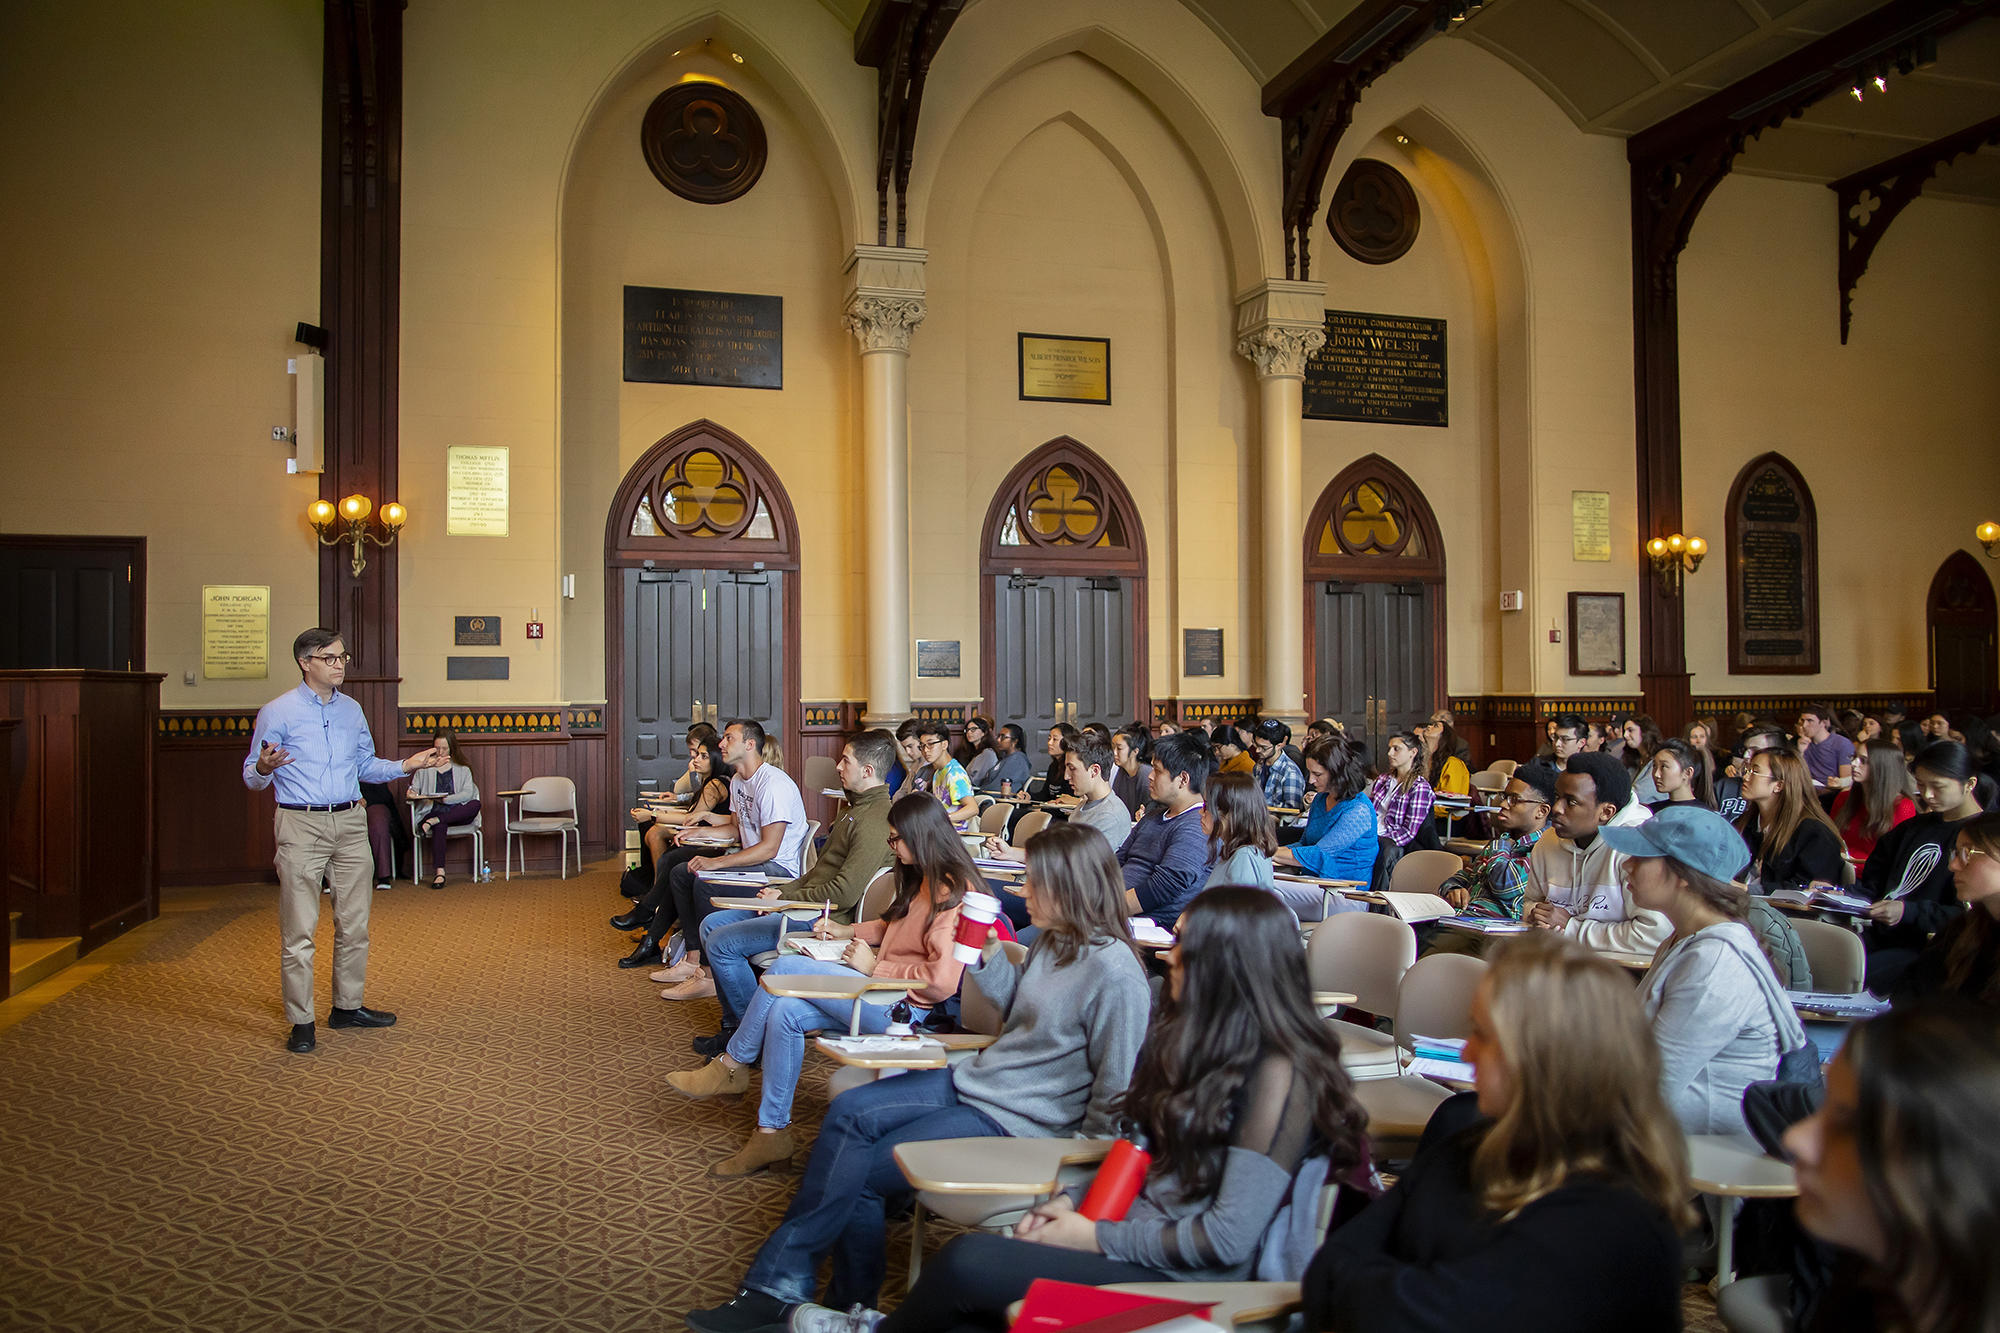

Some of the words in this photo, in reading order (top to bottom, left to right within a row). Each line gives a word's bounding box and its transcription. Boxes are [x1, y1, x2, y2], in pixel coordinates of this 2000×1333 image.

[1328, 316, 1368, 326] GRATEFUL
[1370, 319, 1432, 331] COMMEMORATION
[1329, 334, 1365, 348] JOHN
[1370, 337, 1420, 352] WELSH
[1322, 355, 1360, 364] CENTENNIAL
[1327, 348, 1368, 356] PROMOTING
[1308, 362, 1324, 370] THE
[1327, 364, 1367, 374] CITIZENS
[1370, 366, 1380, 374] OF
[1383, 368, 1442, 378] PHILADELPHIA
[1367, 400, 1412, 408] UNIVERSITY
[1504, 593, 1516, 608] EXIT
